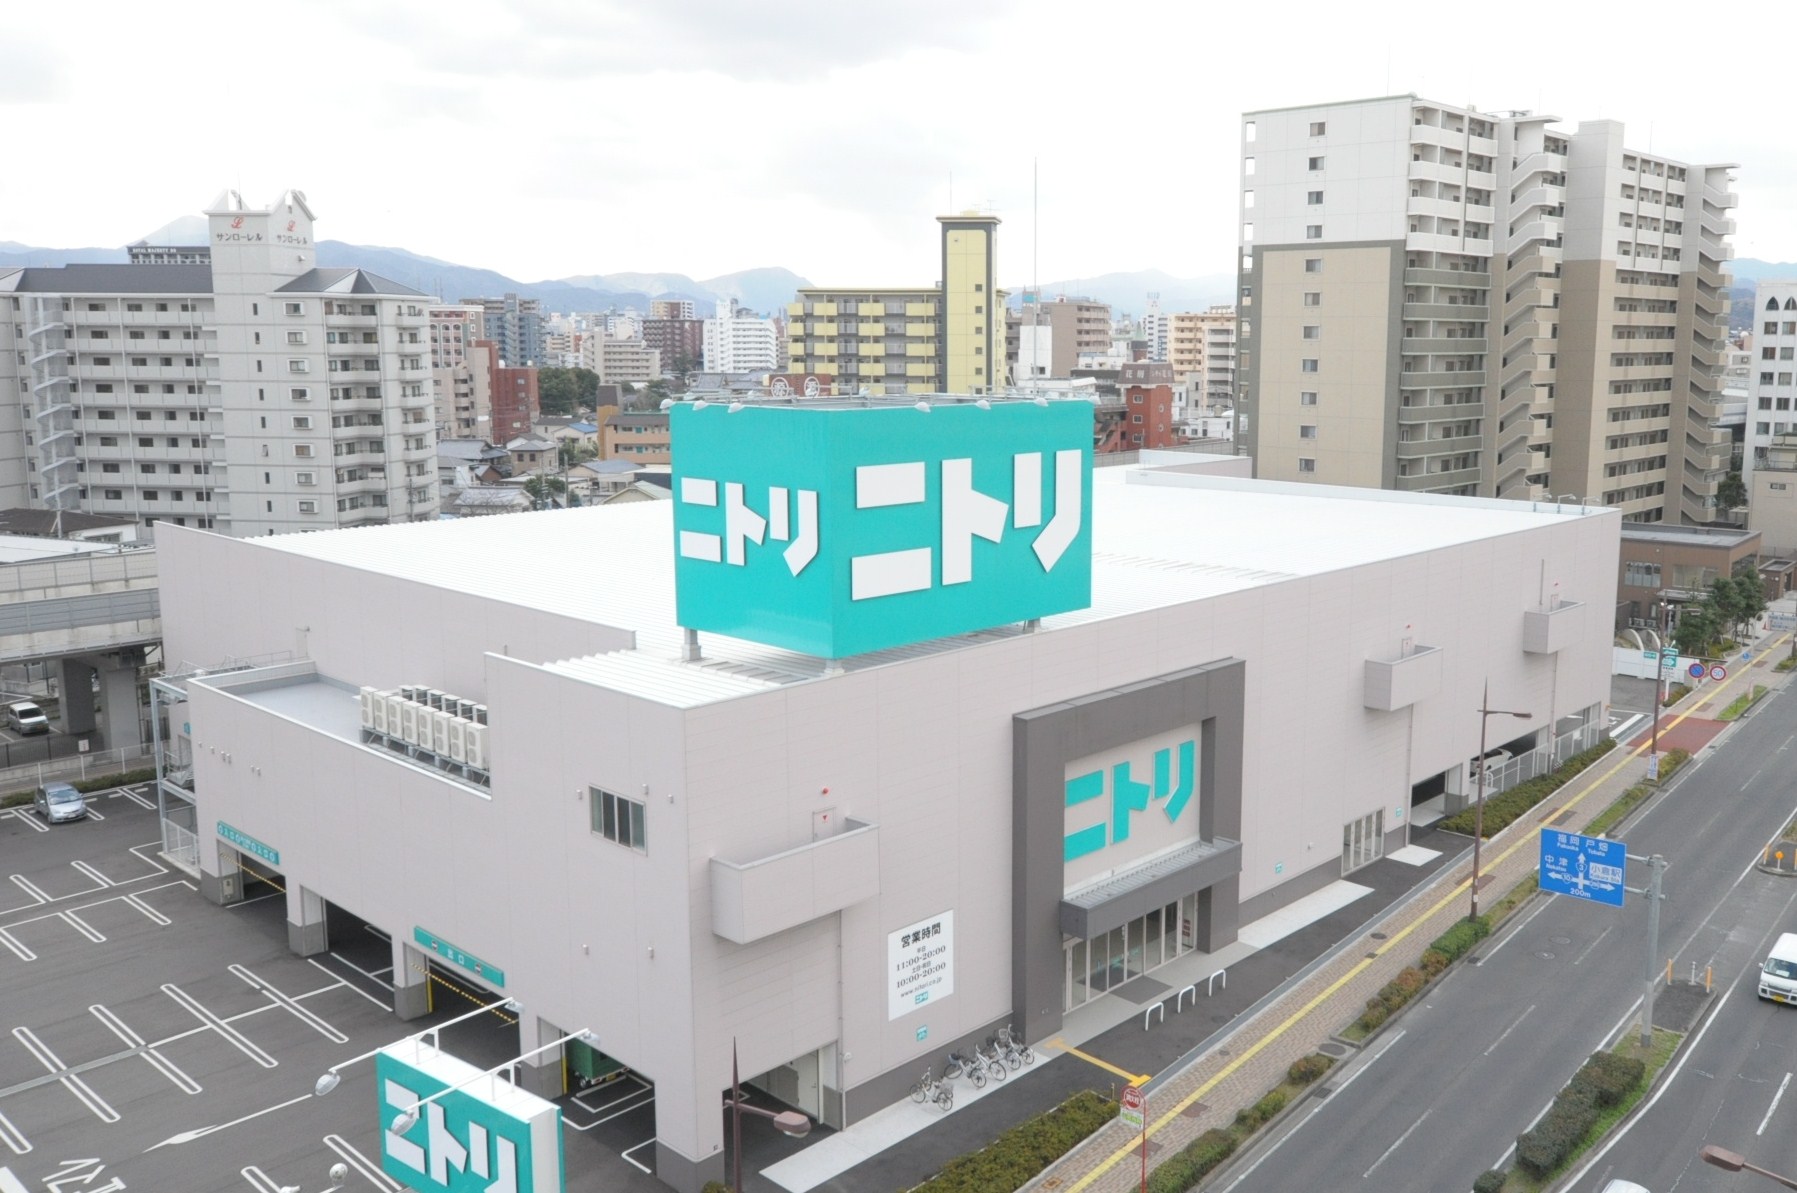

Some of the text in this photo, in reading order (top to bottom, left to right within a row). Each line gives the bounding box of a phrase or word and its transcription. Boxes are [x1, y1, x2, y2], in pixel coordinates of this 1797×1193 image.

[216, 233, 263, 242] サンローレル
[277, 234, 308, 245] サンローレル
[679, 477, 819, 578] ニトリ
[852, 448, 1082, 601] ニトリ
[1064, 740, 1195, 861] ニトリ
[1544, 854, 1568, 866] 中津
[1591, 864, 1621, 878] 小倉駅
[1570, 888, 1591, 898] 200m
[900, 921, 941, 948] 営業時間
[896, 945, 946, 972] 11:00-20:00
[896, 962, 946, 989] 10:00-20:00
[385, 1078, 517, 1193] ニトリ
